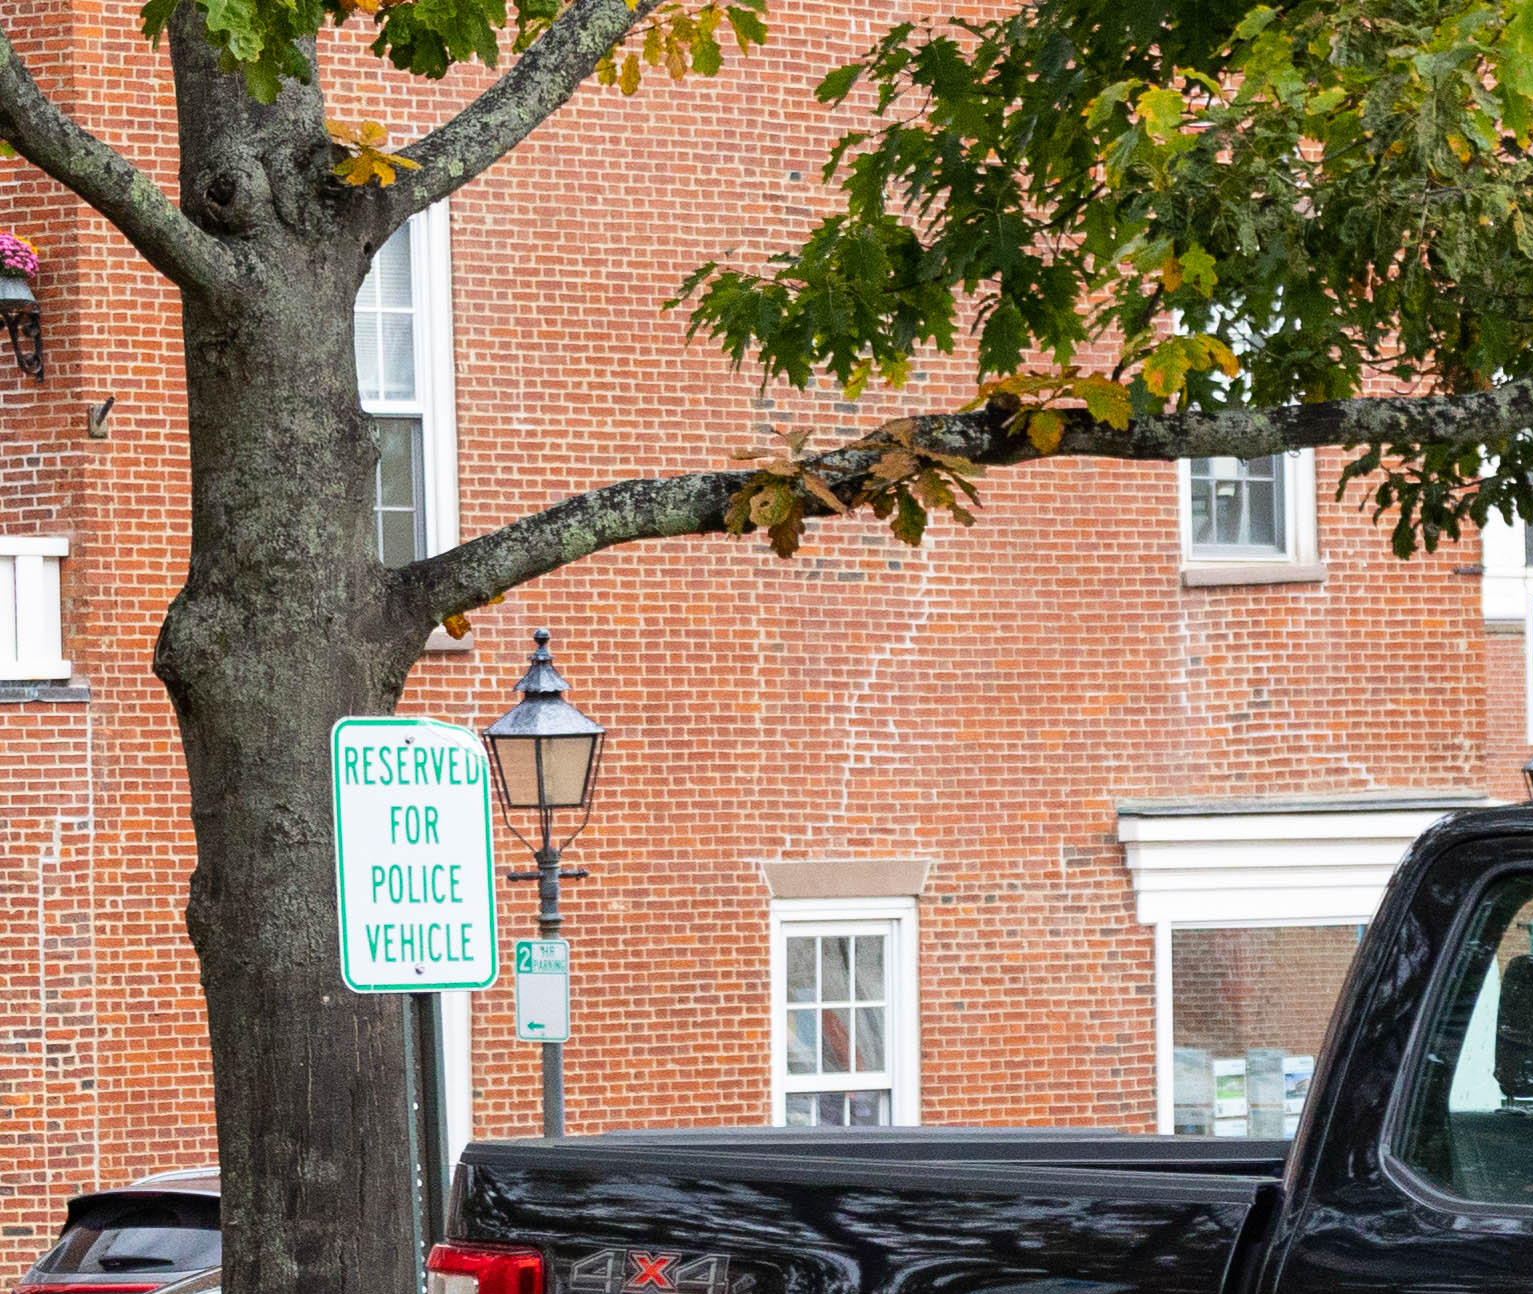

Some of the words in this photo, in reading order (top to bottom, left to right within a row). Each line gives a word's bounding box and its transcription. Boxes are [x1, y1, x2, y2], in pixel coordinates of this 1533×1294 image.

[345, 746, 480, 785] RESERVED
[390, 805, 439, 845] FOR
[371, 864, 463, 904] POLICE
[366, 923, 474, 962] VEHICLE
[519, 946, 530, 970] 2
